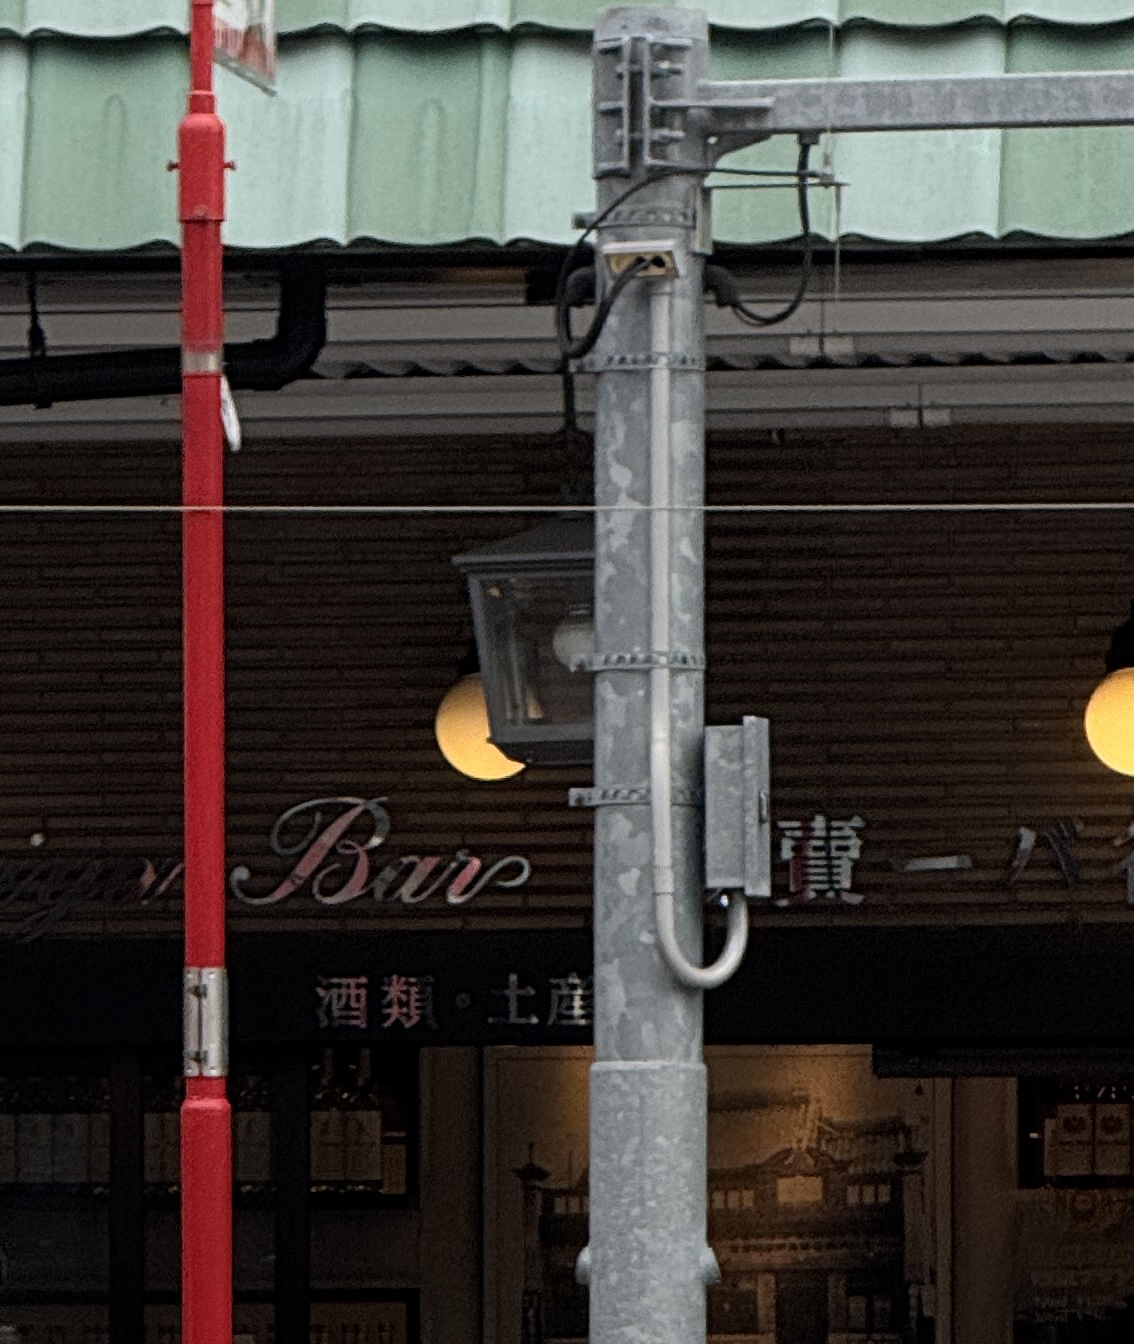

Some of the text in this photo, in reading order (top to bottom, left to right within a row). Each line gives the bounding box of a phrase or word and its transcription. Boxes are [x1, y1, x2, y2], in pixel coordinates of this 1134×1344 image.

[230, 795, 531, 907] Bar
[314, 972, 594, 1030] 酒類・土産
